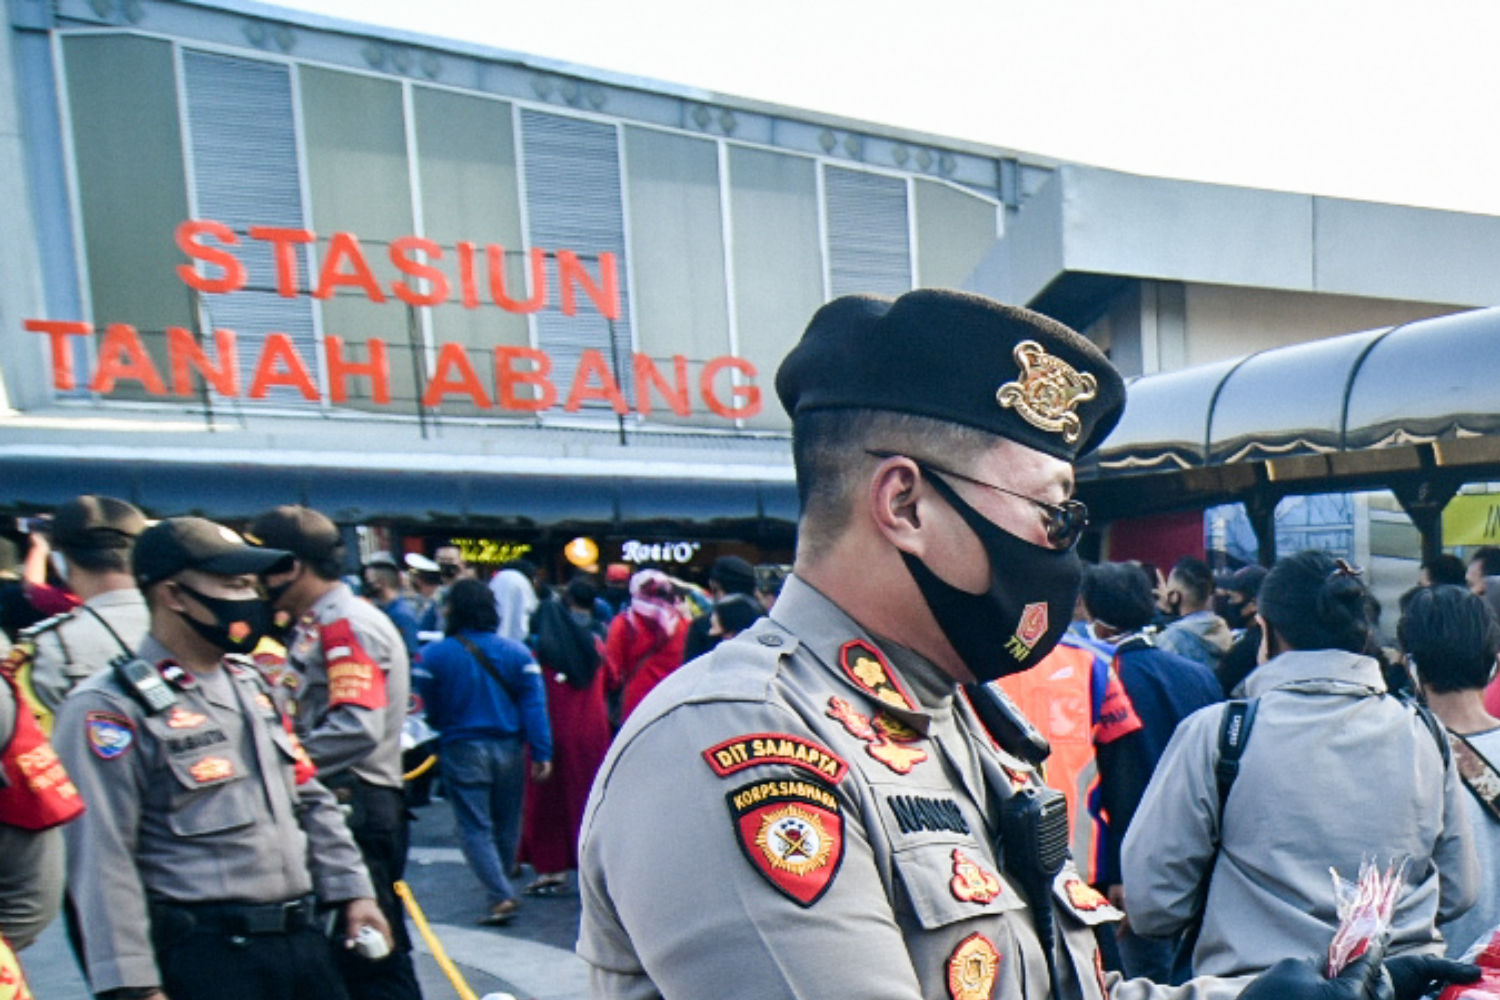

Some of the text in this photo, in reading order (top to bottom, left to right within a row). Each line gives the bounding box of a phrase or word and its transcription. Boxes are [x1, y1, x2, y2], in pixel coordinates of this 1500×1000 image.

[175, 219, 620, 320] STASIUN
[23, 319, 763, 419] TANAH ABANG
[716, 739, 838, 777] DIT SAMAPTA
[733, 781, 779, 811] KORPS
